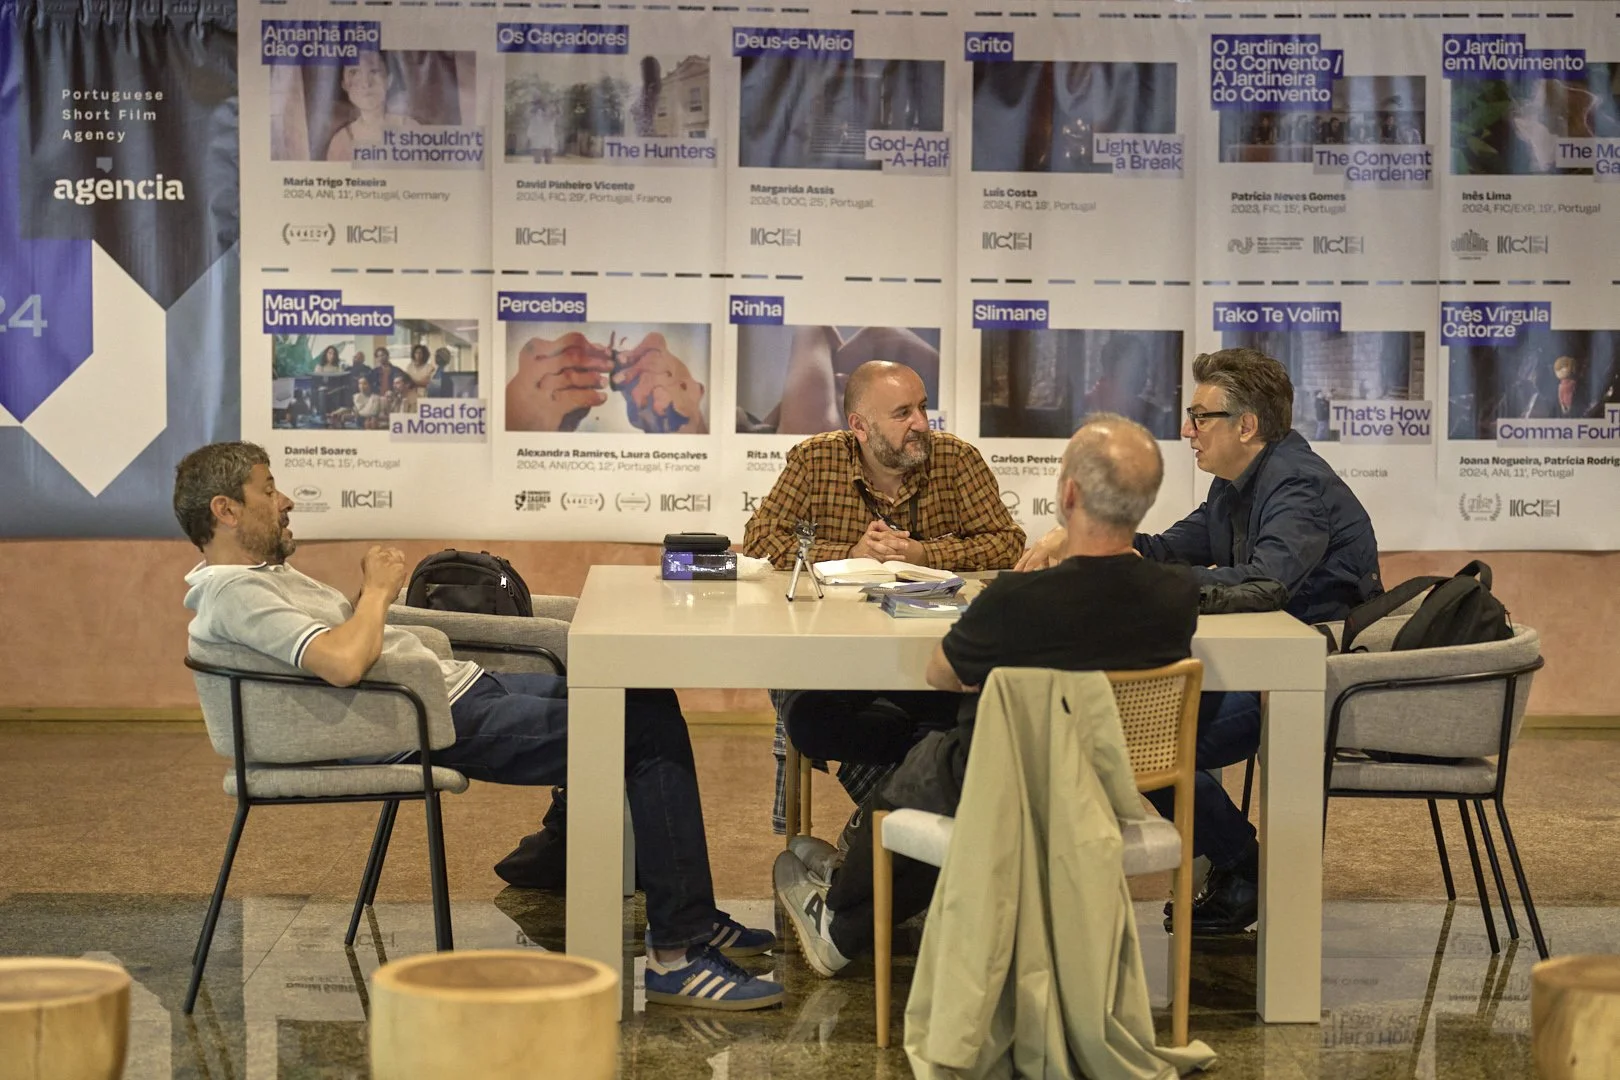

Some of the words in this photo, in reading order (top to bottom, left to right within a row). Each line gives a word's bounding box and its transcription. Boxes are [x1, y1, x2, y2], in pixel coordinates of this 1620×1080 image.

[263, 26, 340, 43] Amanhã
[345, 28, 379, 43] não
[499, 29, 524, 44] Os
[528, 28, 627, 48] Caçadores
[735, 33, 852, 50] Deus-e-Meio
[264, 42, 299, 57] dão
[302, 42, 357, 57] chuva
[967, 37, 1012, 53] Grito
[1213, 39, 1229, 55] O
[1232, 39, 1318, 55] Jardineiro
[1445, 39, 1460, 54] O
[1464, 39, 1523, 54] Jardim
[1213, 56, 1236, 71] do
[1241, 56, 1330, 71] Convento
[1334, 55, 1342, 74] /
[1445, 58, 1475, 70] em
[1480, 55, 1583, 70] Movimento
[1212, 72, 1227, 86] A
[1231, 71, 1316, 86] Jardineira
[62, 89, 163, 102] Portuguese
[1213, 87, 1236, 102] do
[1241, 87, 1330, 102] Convento
[62, 109, 110, 120] Short
[119, 109, 157, 120] Film
[62, 129, 125, 143] Agency
[383, 130, 395, 145] It
[400, 130, 483, 146] shouldn't
[868, 136, 949, 151] God-And
[354, 146, 387, 161] rain
[393, 148, 483, 161] tomorrow
[607, 142, 639, 158] The
[644, 142, 716, 160] Hunters
[1096, 138, 1138, 157] Light
[1143, 139, 1182, 154] Was
[1559, 143, 1592, 159] The
[885, 152, 949, 168] -A-Half
[1116, 159, 1125, 169] a
[1131, 155, 1182, 170] Break
[1316, 150, 1348, 166] The
[1353, 150, 1432, 166] Convent
[1346, 166, 1431, 181] Gardener
[283, 177, 314, 186] Maria
[316, 177, 343, 188] Trigo
[345, 178, 387, 187] Teixeira
[516, 180, 547, 189] David
[549, 181, 592, 190] Pinheiro
[594, 181, 635, 190] Vicente
[750, 184, 804, 195] Margarida
[806, 185, 835, 195] Assis
[402, 190, 450, 202] Germany
[1007, 188, 1038, 197] Costa
[1309, 192, 1346, 201] Gomes
[1462, 191, 1484, 200] Inês
[1486, 191, 1512, 200] Lima
[1558, 203, 1601, 215] Portugal
[265, 295, 305, 310] Mau
[309, 295, 340, 310] Por
[499, 297, 585, 314] Percebes
[732, 301, 782, 317] Rinha
[265, 310, 299, 326] Um
[302, 311, 392, 327] Momento
[975, 304, 1047, 321] Slimane
[1216, 308, 1259, 323] Tako
[1261, 308, 1284, 323] Te
[1288, 307, 1340, 323] Volim
[1443, 307, 1482, 322] Três
[1486, 305, 1550, 325] Vírgula
[1443, 322, 1516, 338] Catorze
[420, 404, 455, 418] Bad
[460, 404, 486, 418] for
[1333, 406, 1386, 421] That's
[1390, 406, 1431, 421] How
[392, 423, 403, 434] a
[408, 419, 486, 435] Moment
[1342, 422, 1347, 436] I
[1352, 422, 1394, 436] Love
[1399, 422, 1430, 436] You
[1499, 424, 1573, 440] Comma
[1577, 425, 1620, 440] Four
[284, 446, 318, 455] Daniel
[320, 446, 358, 455] Soares
[517, 449, 570, 458] Alexandra
[621, 450, 650, 459] Laura
[652, 450, 708, 461] Gonçalves
[747, 450, 768, 459] Rita
[357, 458, 401, 470] Portugal
[991, 454, 1025, 463] Carlos
[1459, 456, 1490, 465] Joana
[1544, 455, 1585, 465] Patrícia
[665, 462, 701, 473] France
[1351, 468, 1388, 478] Croatia
[1531, 468, 1574, 479] Portugal
